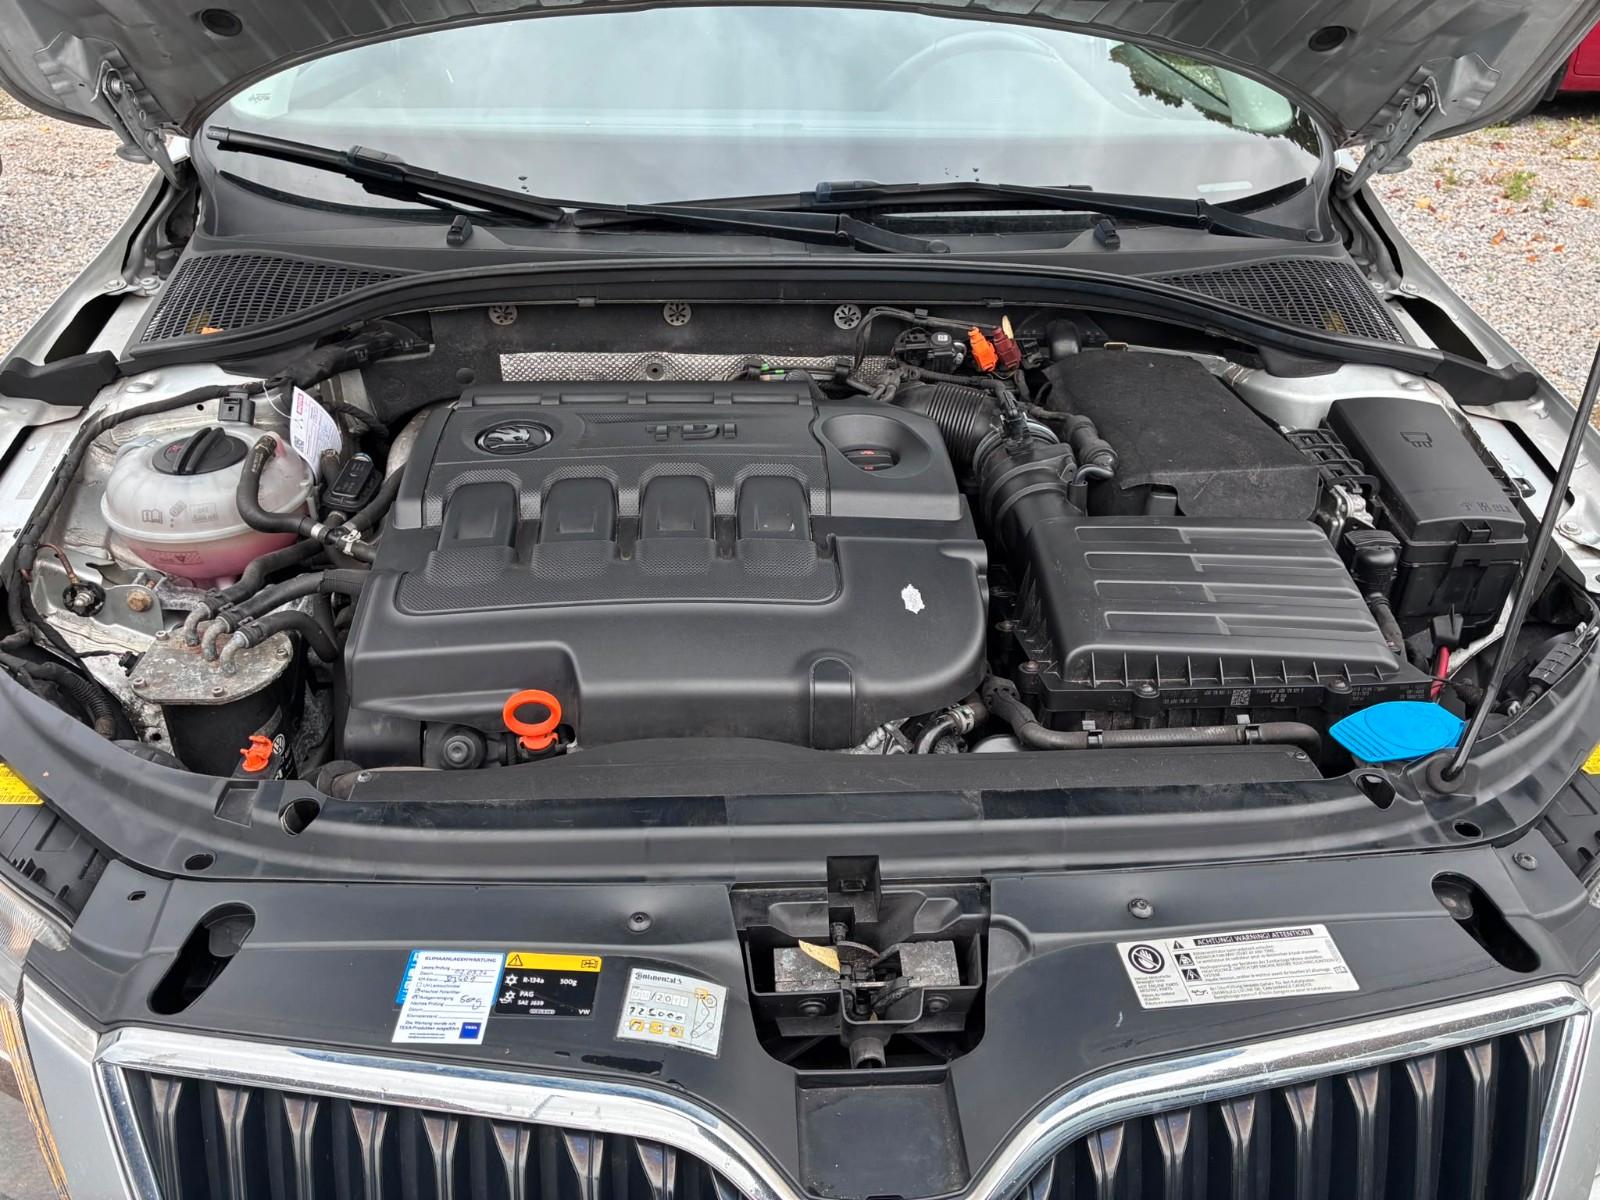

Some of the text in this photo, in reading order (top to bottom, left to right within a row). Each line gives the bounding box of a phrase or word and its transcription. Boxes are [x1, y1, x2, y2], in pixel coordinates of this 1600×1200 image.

[646, 423, 737, 441] TDI
[1197, 929, 1311, 945] ACHTUNG! WARNING! ATTENTION!
[519, 990, 535, 998] PAG
